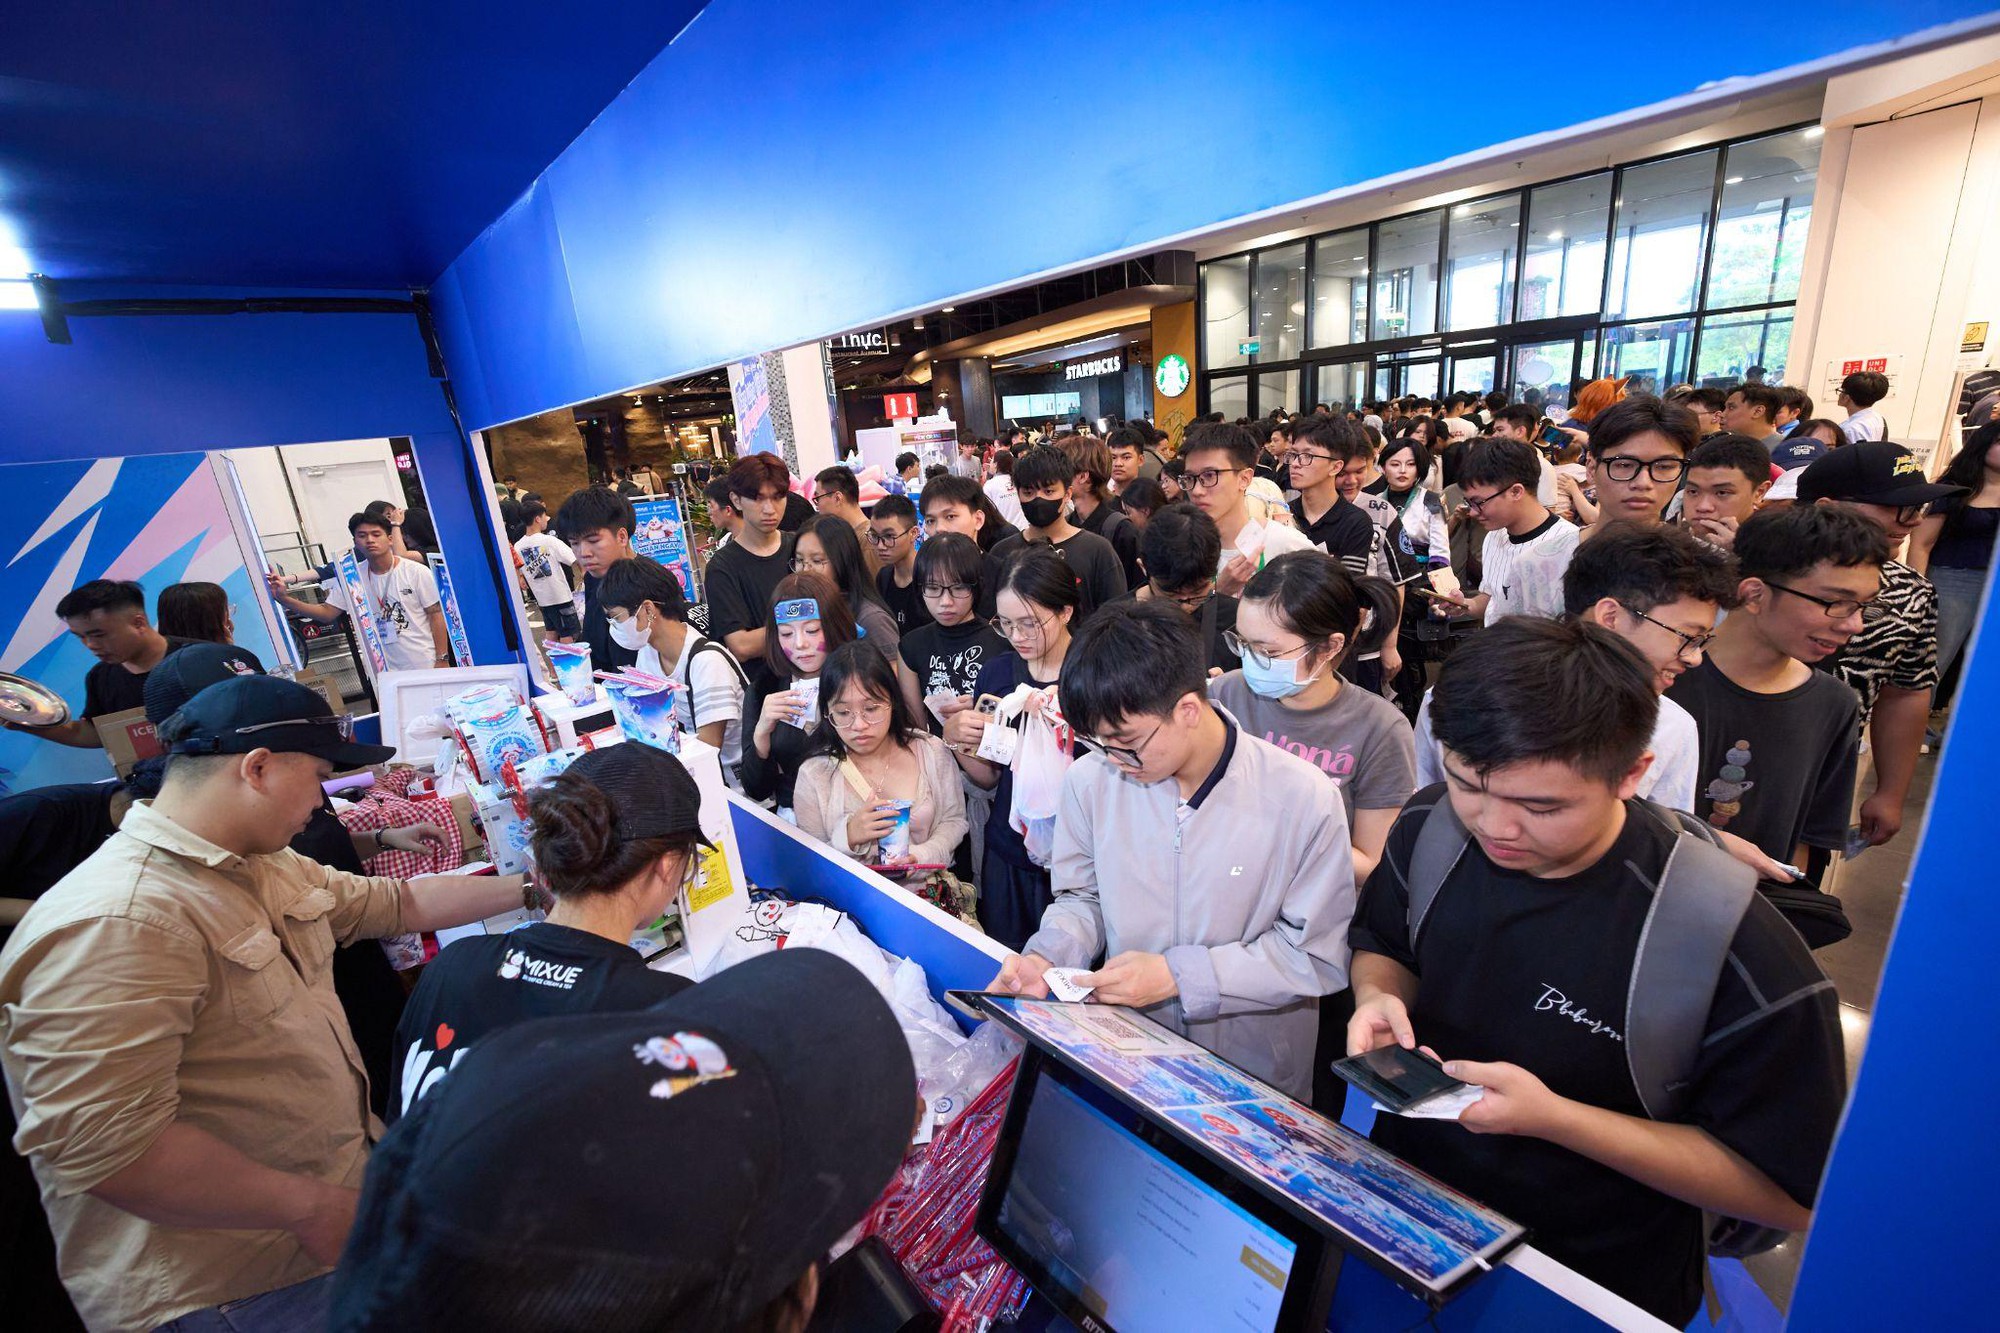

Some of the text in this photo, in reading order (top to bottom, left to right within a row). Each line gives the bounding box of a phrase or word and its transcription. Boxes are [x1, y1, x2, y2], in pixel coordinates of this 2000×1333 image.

[1066, 356, 1120, 380] STARBUCKS
[524, 956, 583, 984] MIXUE
[941, 1256, 978, 1275] CHILLED
